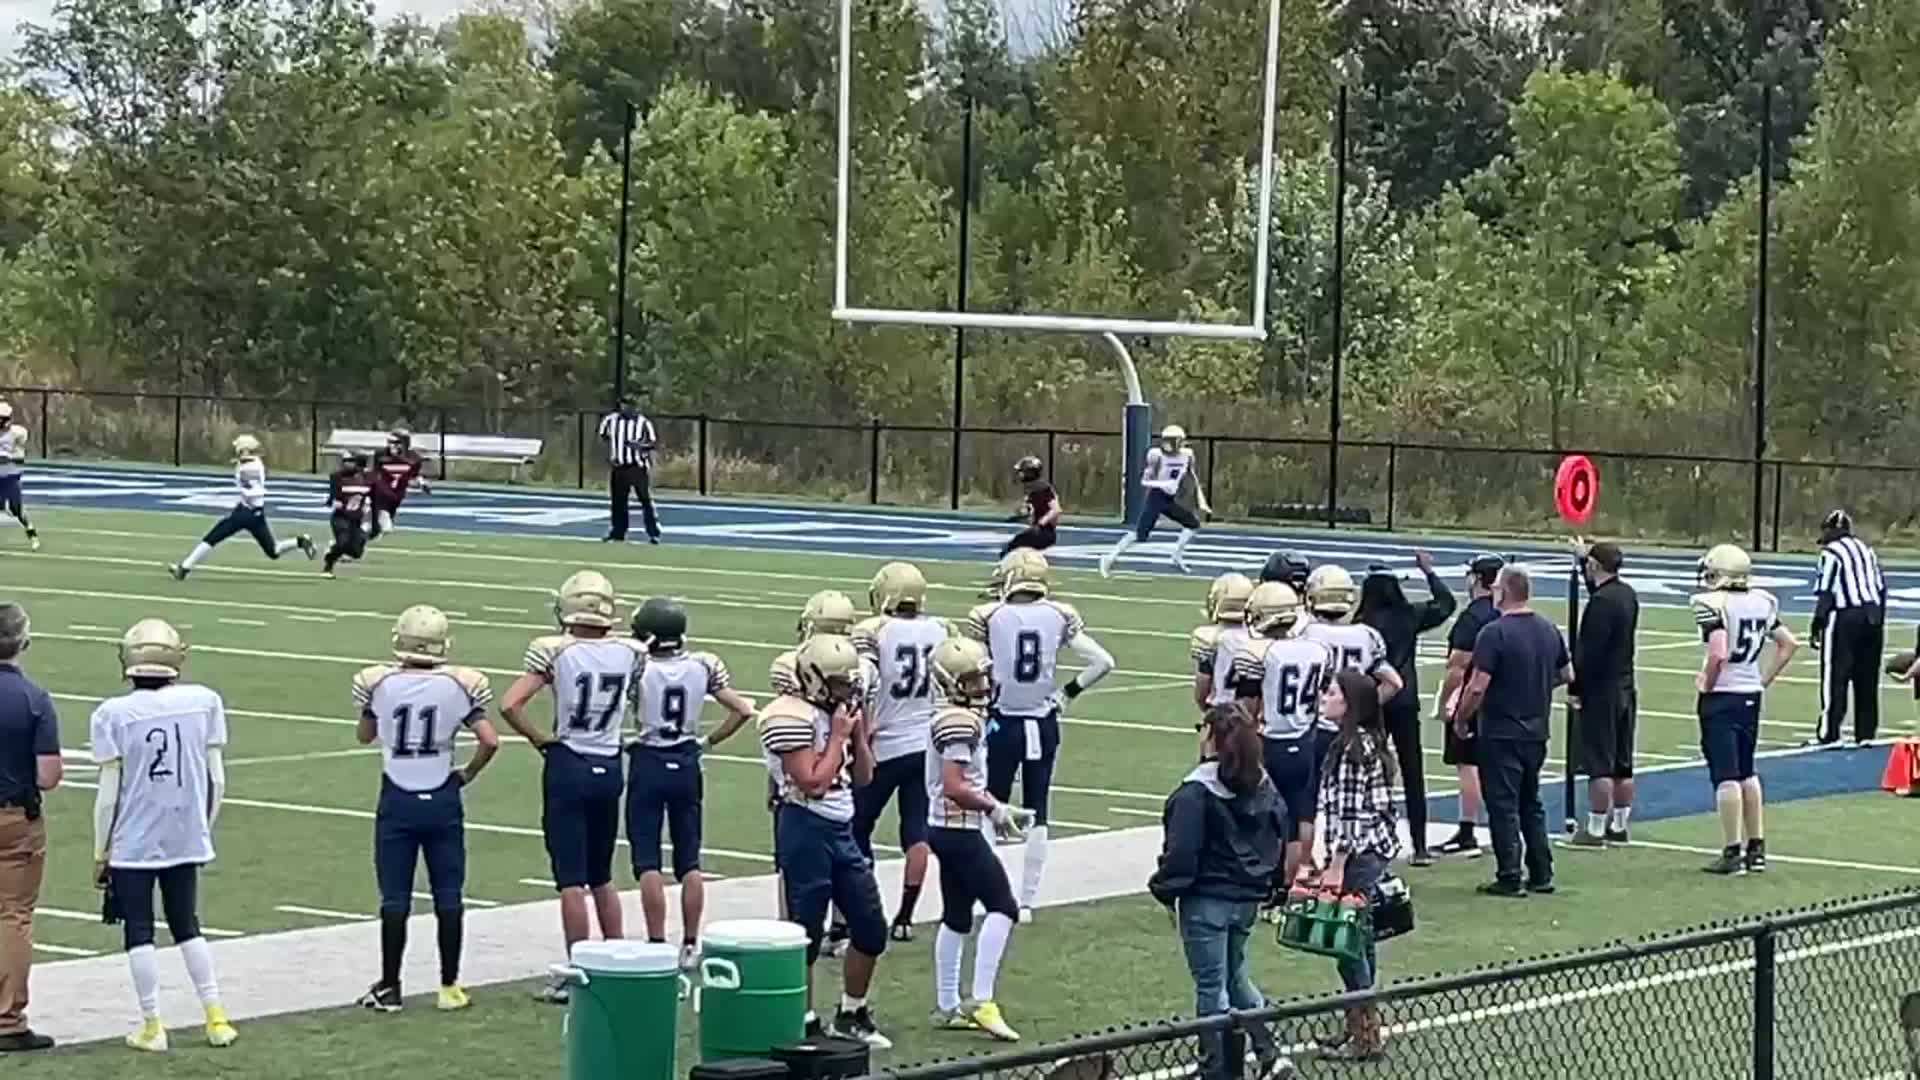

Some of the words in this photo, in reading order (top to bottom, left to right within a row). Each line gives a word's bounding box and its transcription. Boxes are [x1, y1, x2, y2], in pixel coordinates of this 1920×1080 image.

[1014, 629, 1042, 684] 8
[1728, 618, 1768, 664] 57
[568, 671, 627, 732] 17
[658, 685, 688, 740] 9
[1276, 662, 1323, 716] 64
[145, 722, 183, 788] 21
[391, 703, 441, 760] 11
